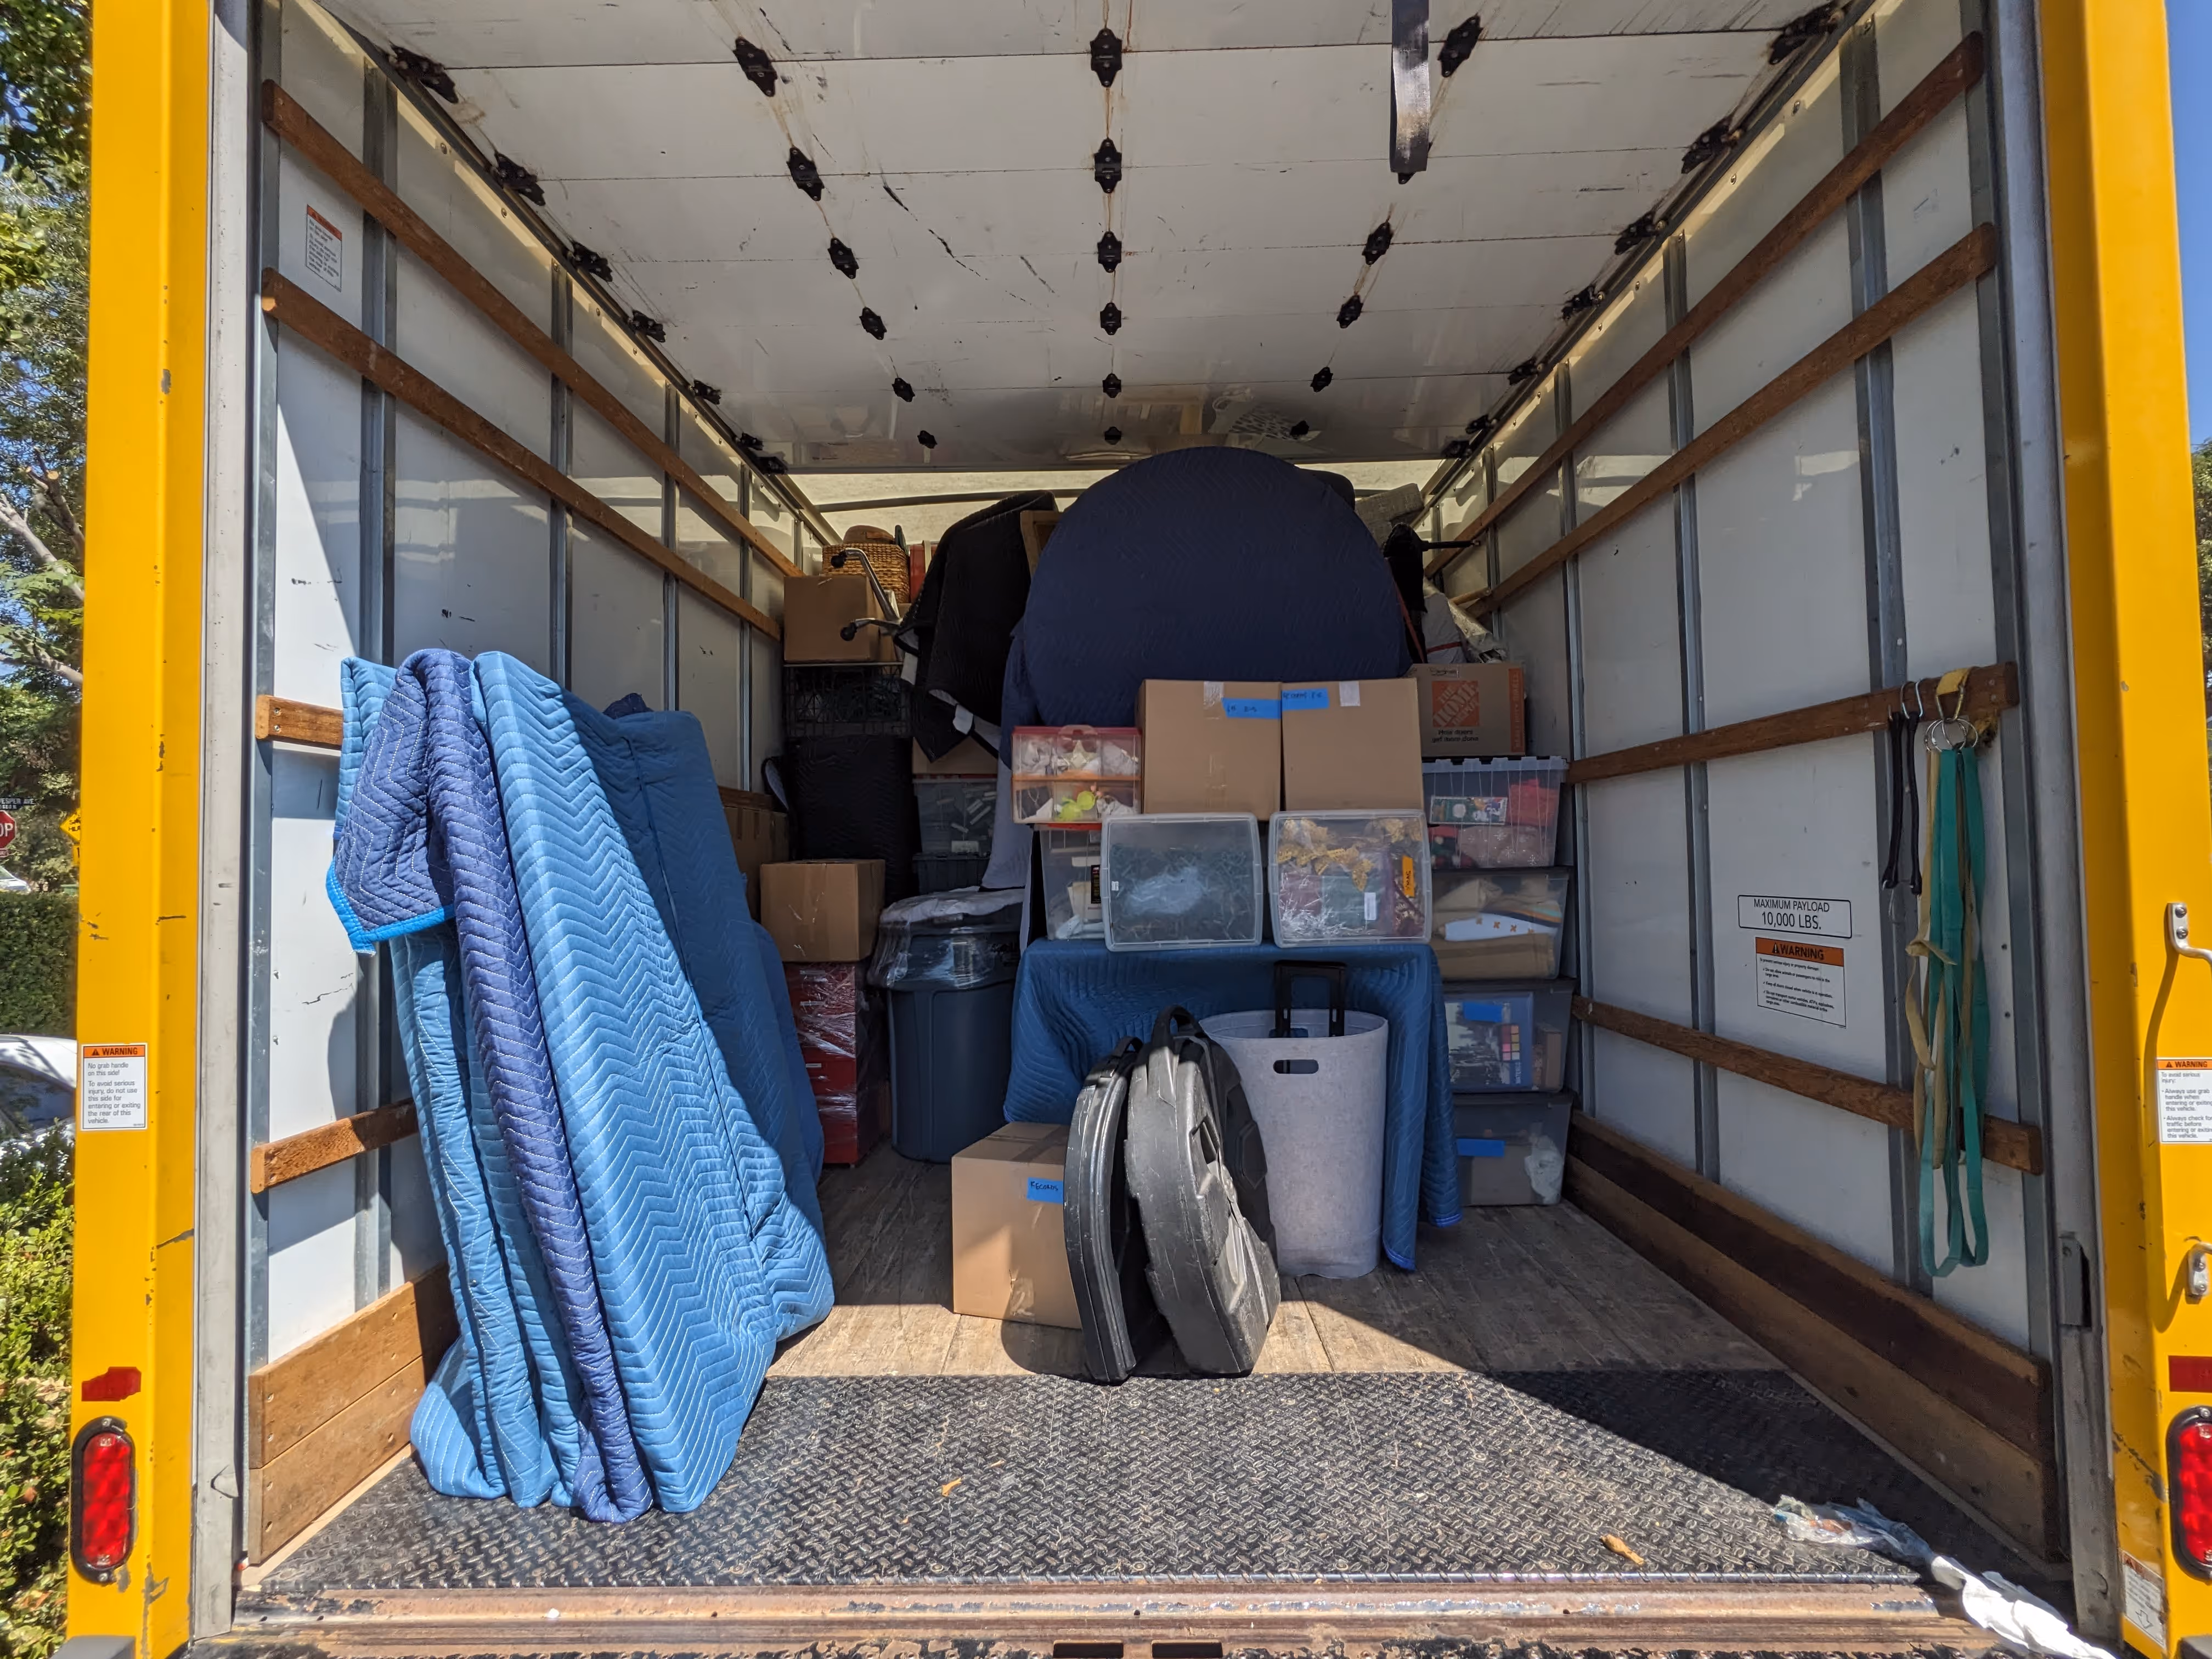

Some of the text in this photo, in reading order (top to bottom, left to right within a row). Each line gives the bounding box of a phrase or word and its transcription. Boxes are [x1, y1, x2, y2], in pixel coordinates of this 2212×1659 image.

[1754, 899, 1830, 912] MAXIMUM PAYLOAD
[1762, 911, 1821, 929] 10,000 LBS.
[1780, 944, 1824, 960] WARNING
[102, 1047, 138, 1056] WARNING
[1030, 1181, 1058, 1191] RECORDS
